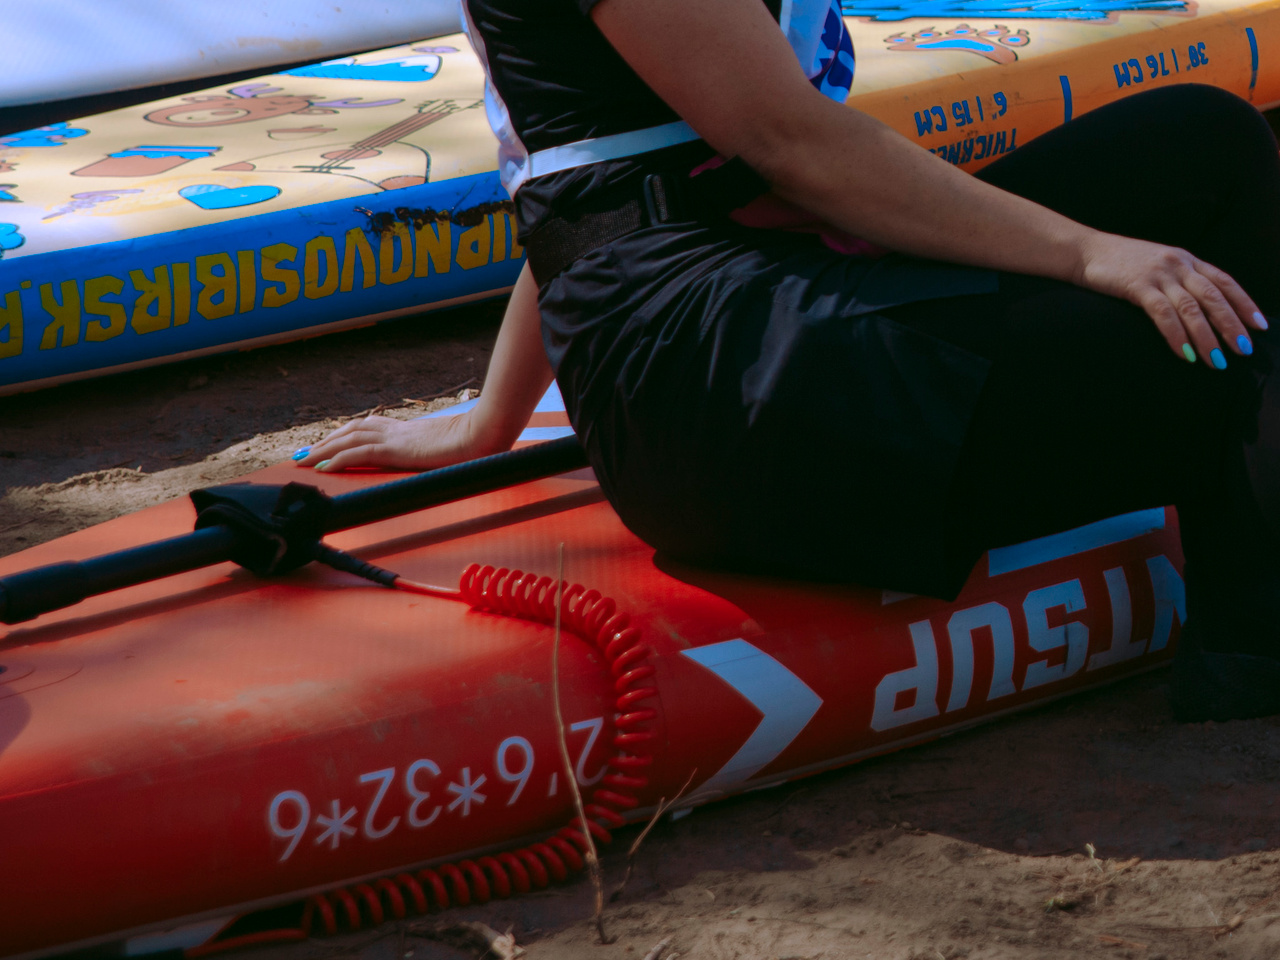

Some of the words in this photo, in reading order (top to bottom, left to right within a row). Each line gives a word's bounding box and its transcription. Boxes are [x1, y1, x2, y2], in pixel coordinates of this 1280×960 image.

[1113, 58, 1144, 88] CM
[1145, 52, 1170, 79] 76
[913, 105, 948, 138] CM
[951, 99, 974, 128] 15
[268, 716, 622, 862] 2'6326
